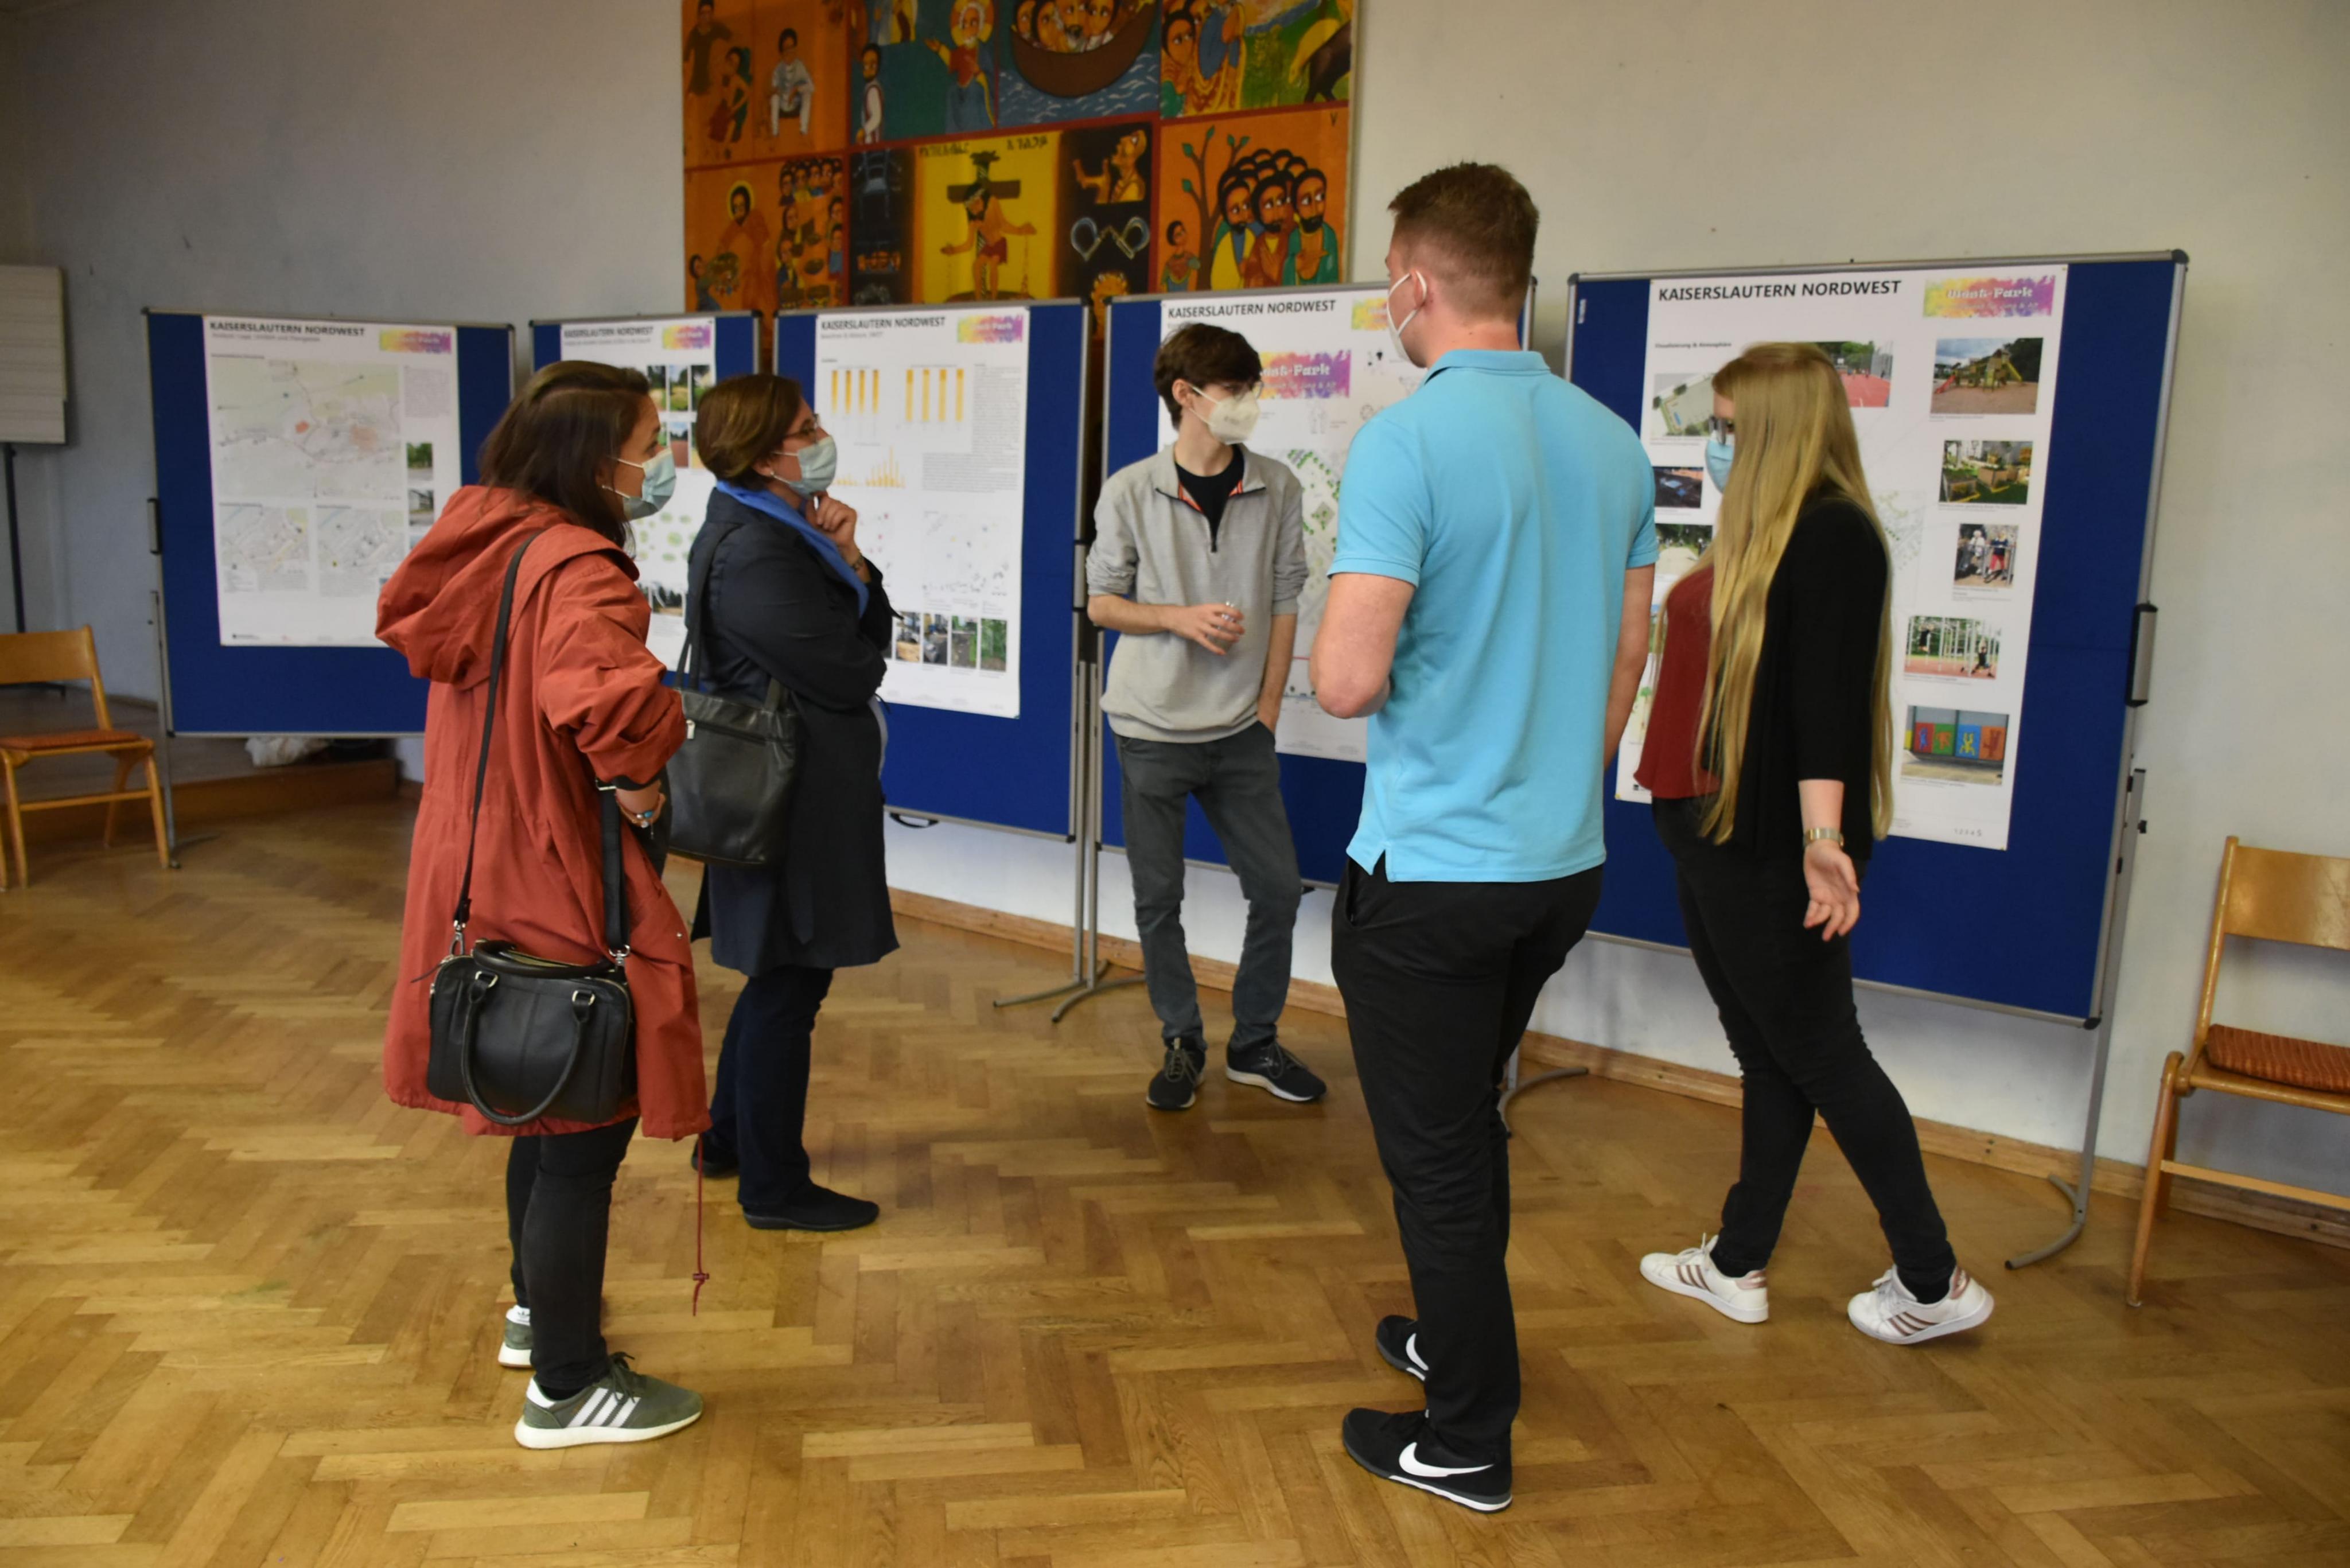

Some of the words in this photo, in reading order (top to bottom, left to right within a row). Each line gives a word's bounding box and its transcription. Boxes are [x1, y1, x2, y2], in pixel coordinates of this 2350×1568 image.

[1659, 283, 1796, 301] KAISERSLAUTERN
[1802, 281, 1902, 296] NORDWEST
[1168, 303, 1263, 318] KAISERSLAUTERN
[1267, 299, 1336, 314] NORDWEST
[209, 322, 302, 334] KAISERSLAUTERN
[305, 325, 365, 337] NORDWEST
[821, 318, 892, 330] KAISERSLAUTERN
[895, 316, 946, 328] NORDWEST
